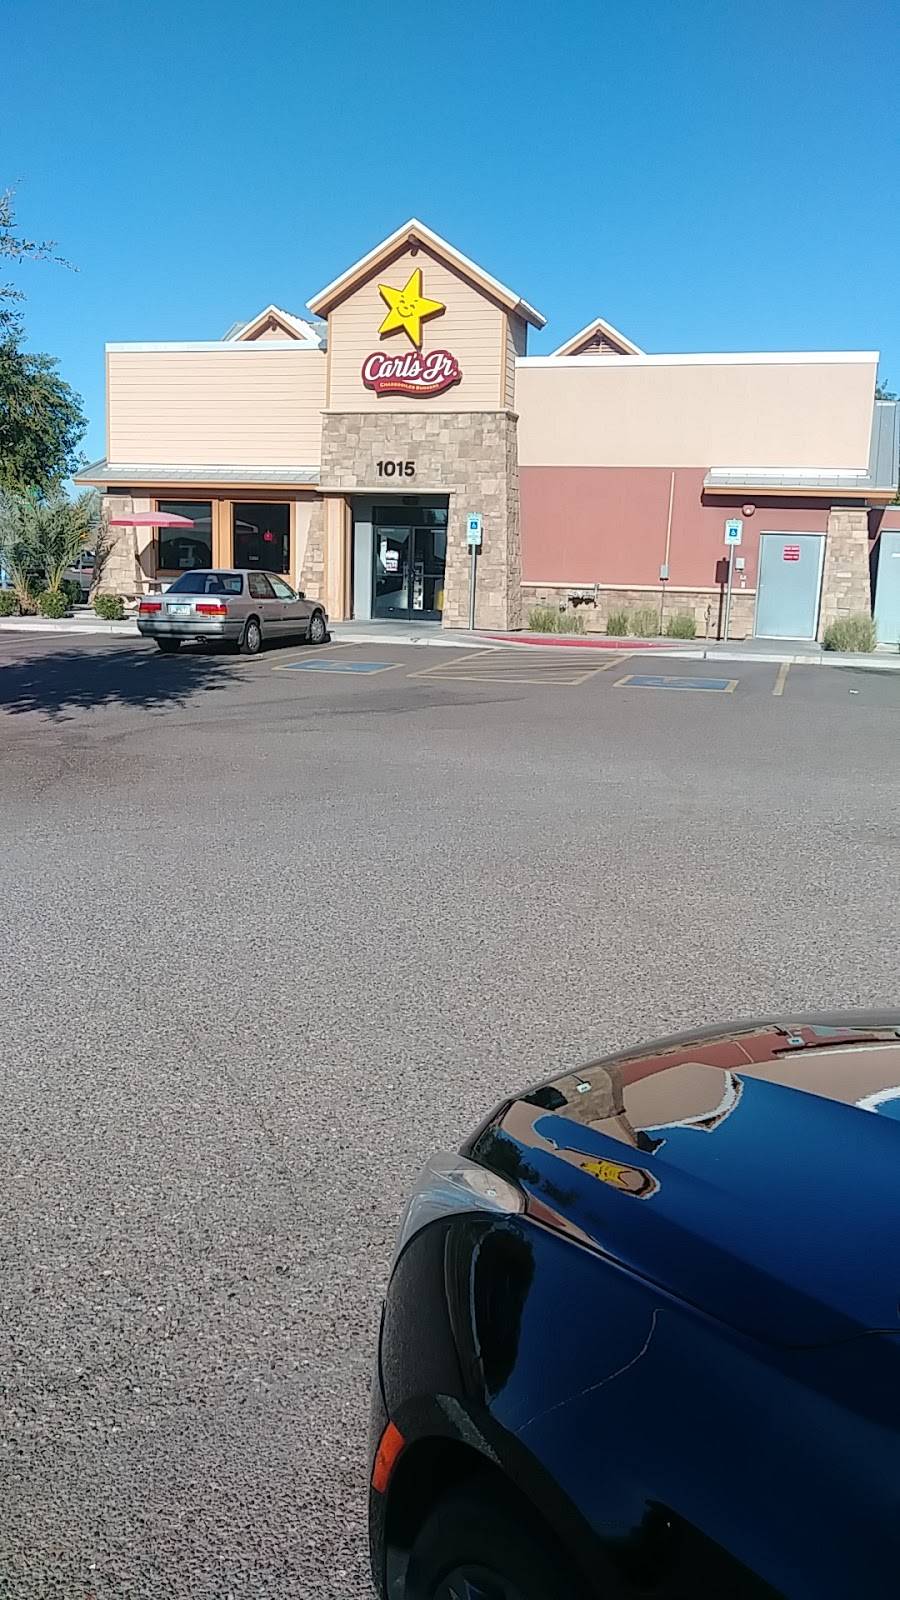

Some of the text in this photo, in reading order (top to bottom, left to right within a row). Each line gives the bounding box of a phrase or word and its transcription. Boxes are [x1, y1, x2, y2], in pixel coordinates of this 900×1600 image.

[364, 353, 457, 381] Carl's Jr.
[376, 460, 415, 477] 1015
